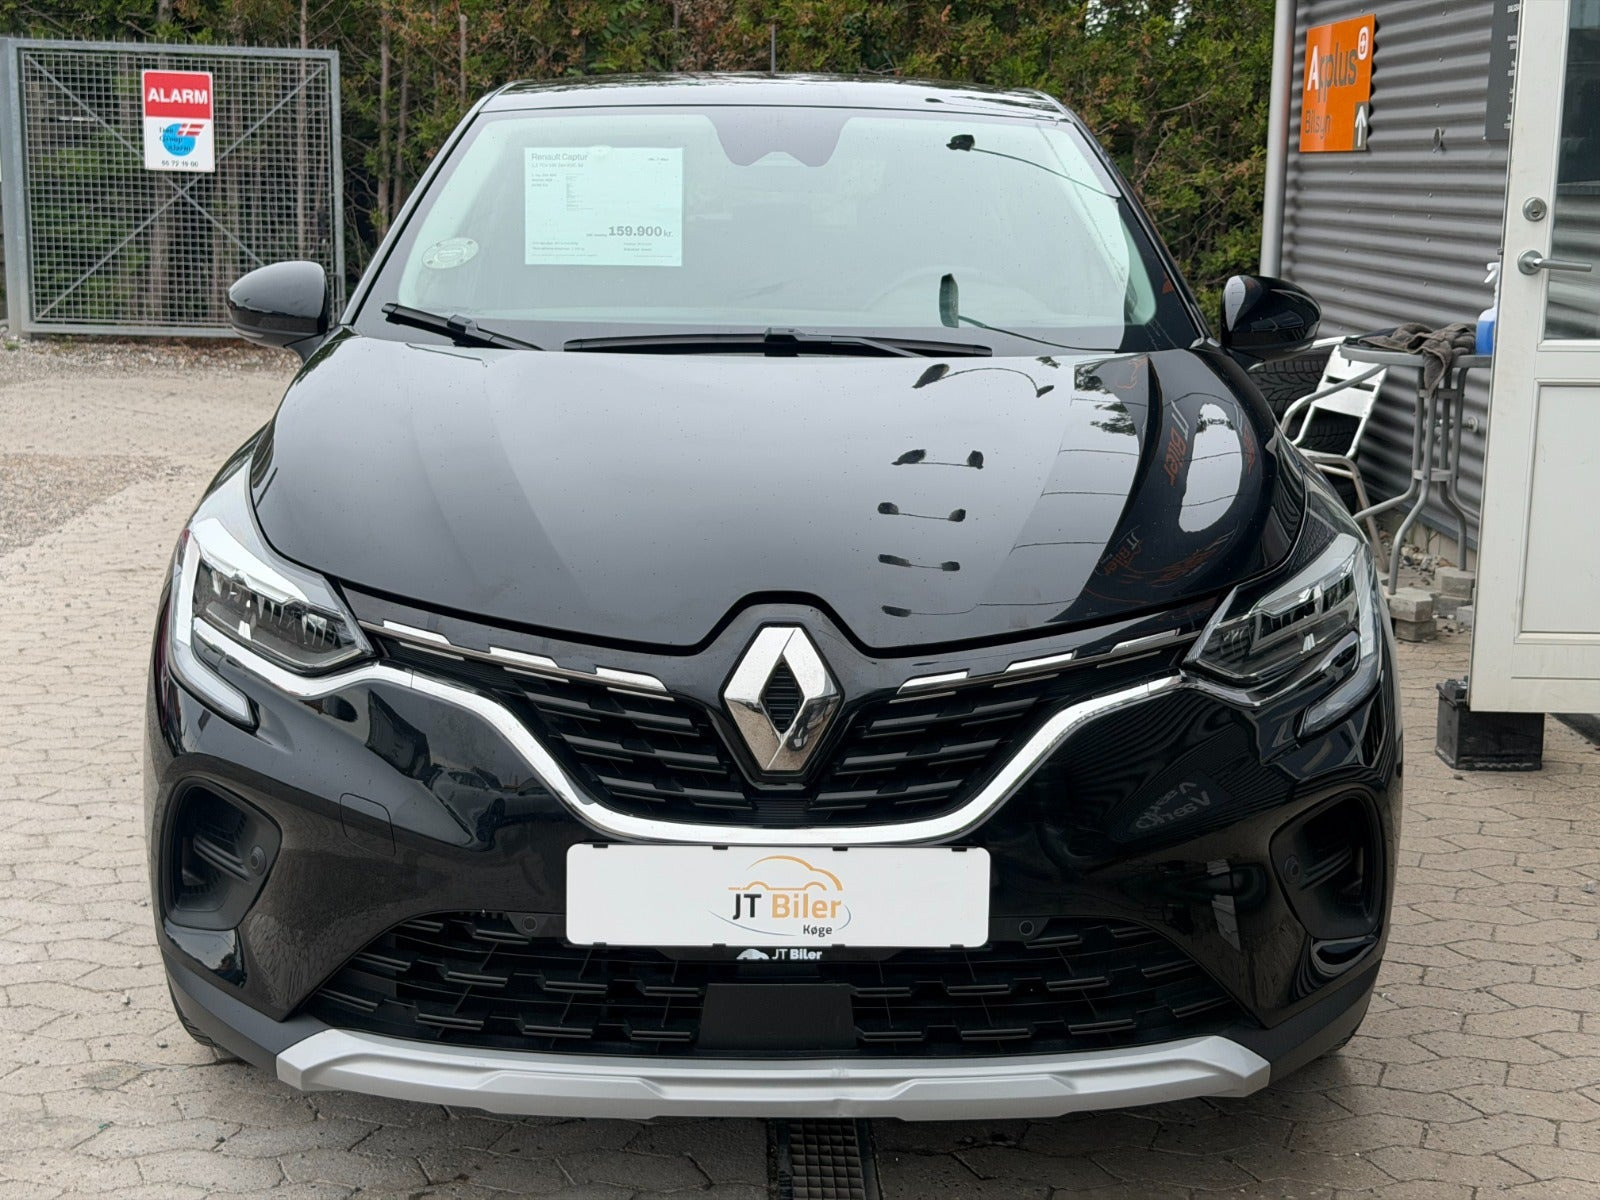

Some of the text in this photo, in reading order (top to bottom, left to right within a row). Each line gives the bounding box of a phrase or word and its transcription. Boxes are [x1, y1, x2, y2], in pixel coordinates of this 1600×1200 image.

[147, 88, 208, 104] ALARM
[531, 152, 588, 163] Renault Captur
[608, 225, 663, 237] 159.900
[732, 893, 842, 920] JT Biler
[803, 924, 833, 938] Køge
[772, 948, 823, 960] JT Biler
